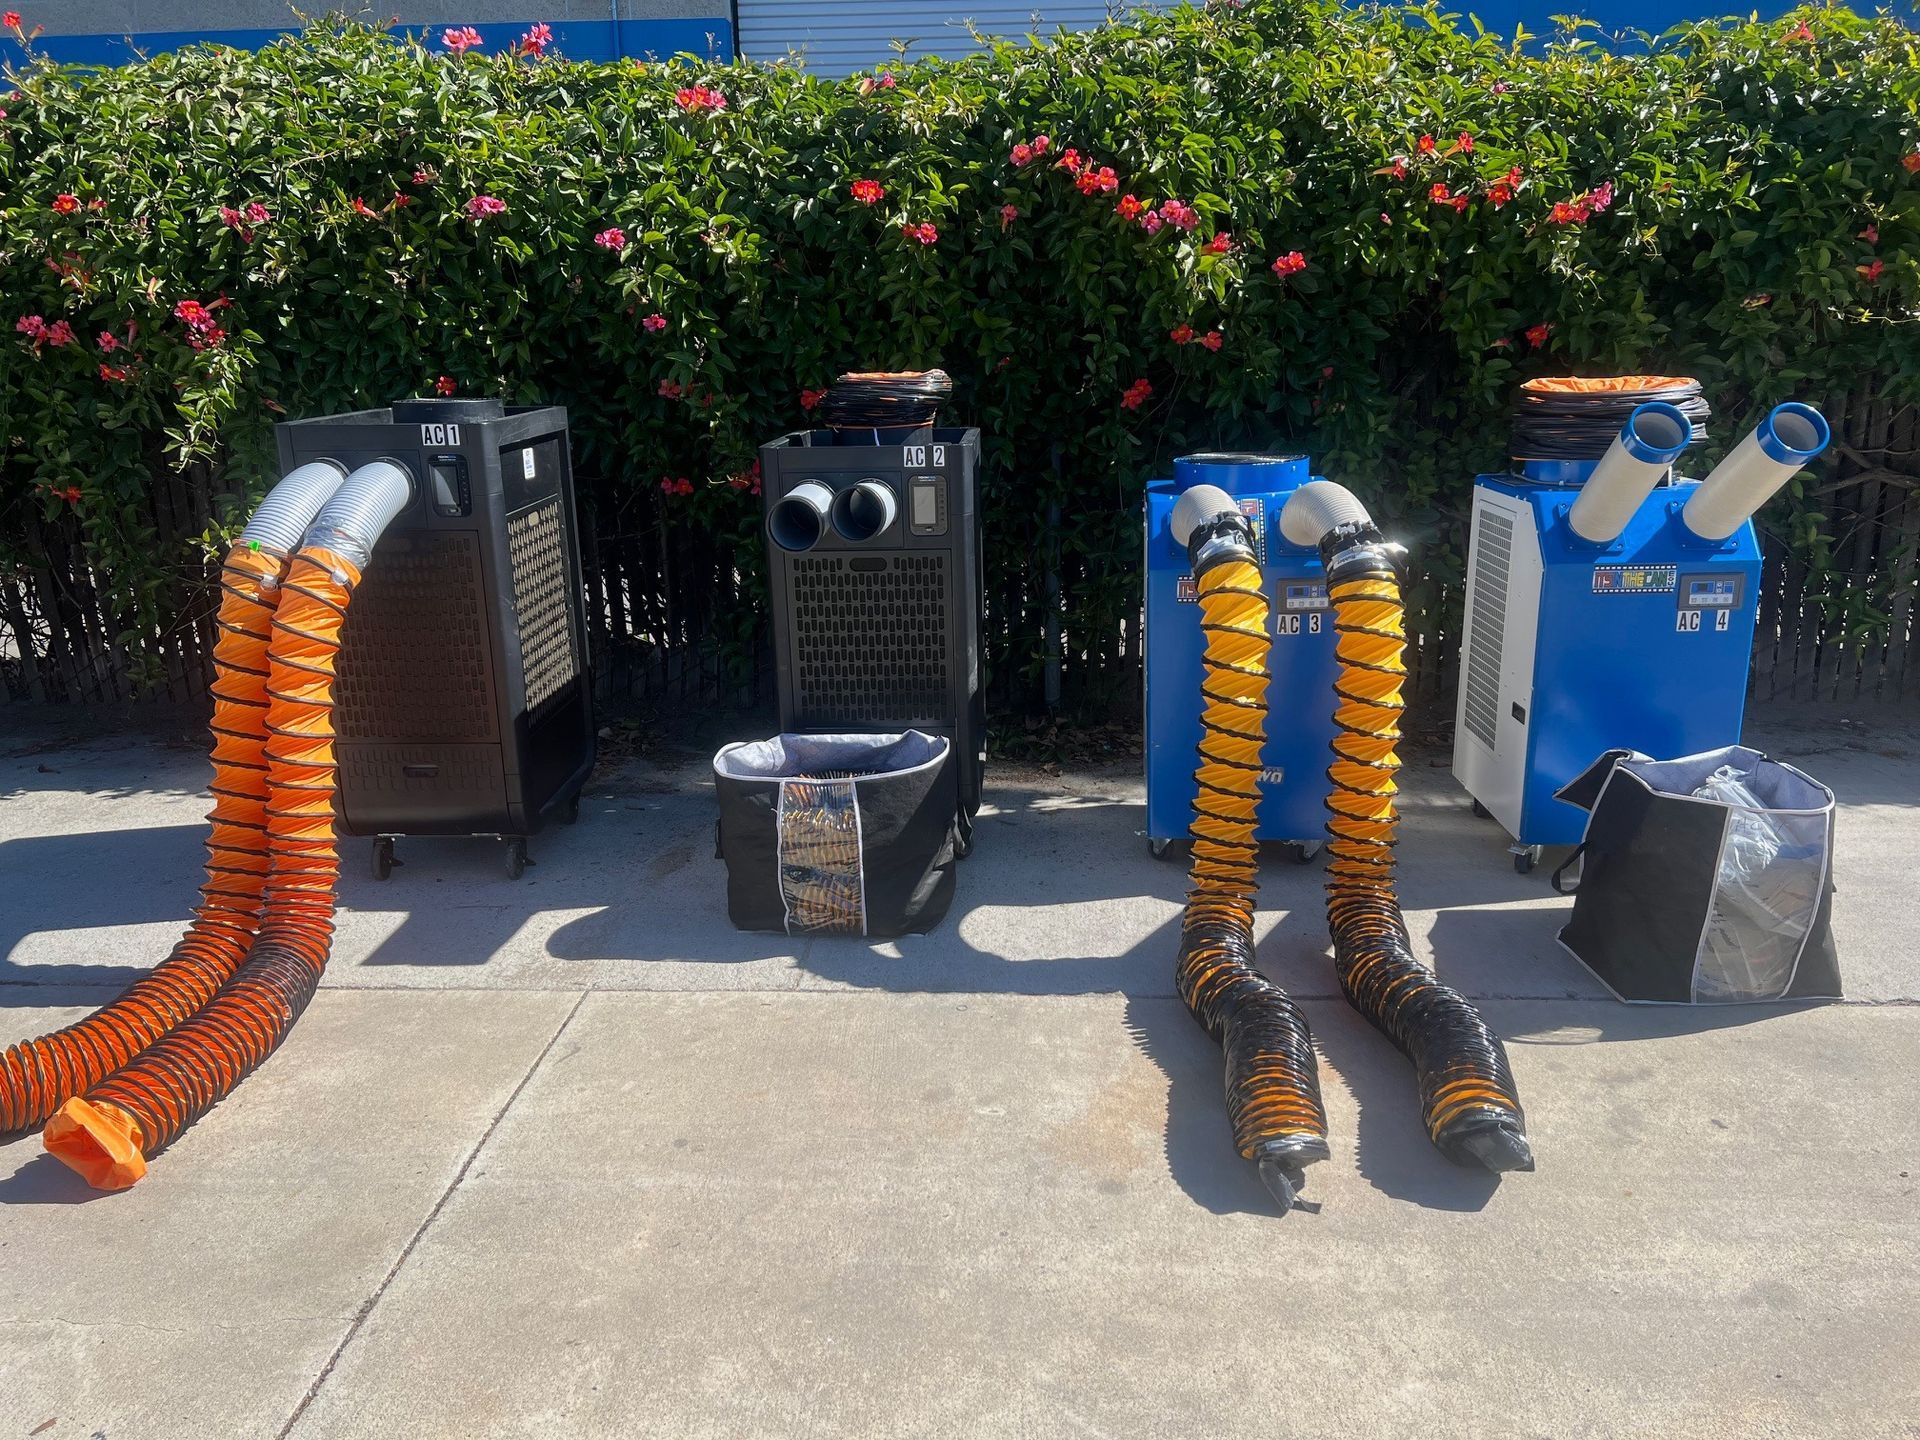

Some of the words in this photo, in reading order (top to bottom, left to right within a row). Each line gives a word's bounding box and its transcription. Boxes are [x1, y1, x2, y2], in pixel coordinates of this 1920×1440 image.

[424, 425, 444, 445] AC
[905, 447, 924, 466] AC
[934, 447, 943, 466] 2
[1278, 615, 1299, 633] AC
[1311, 615, 1319, 633] 3
[1678, 611, 1699, 631] AC
[1717, 611, 1727, 630] 4
